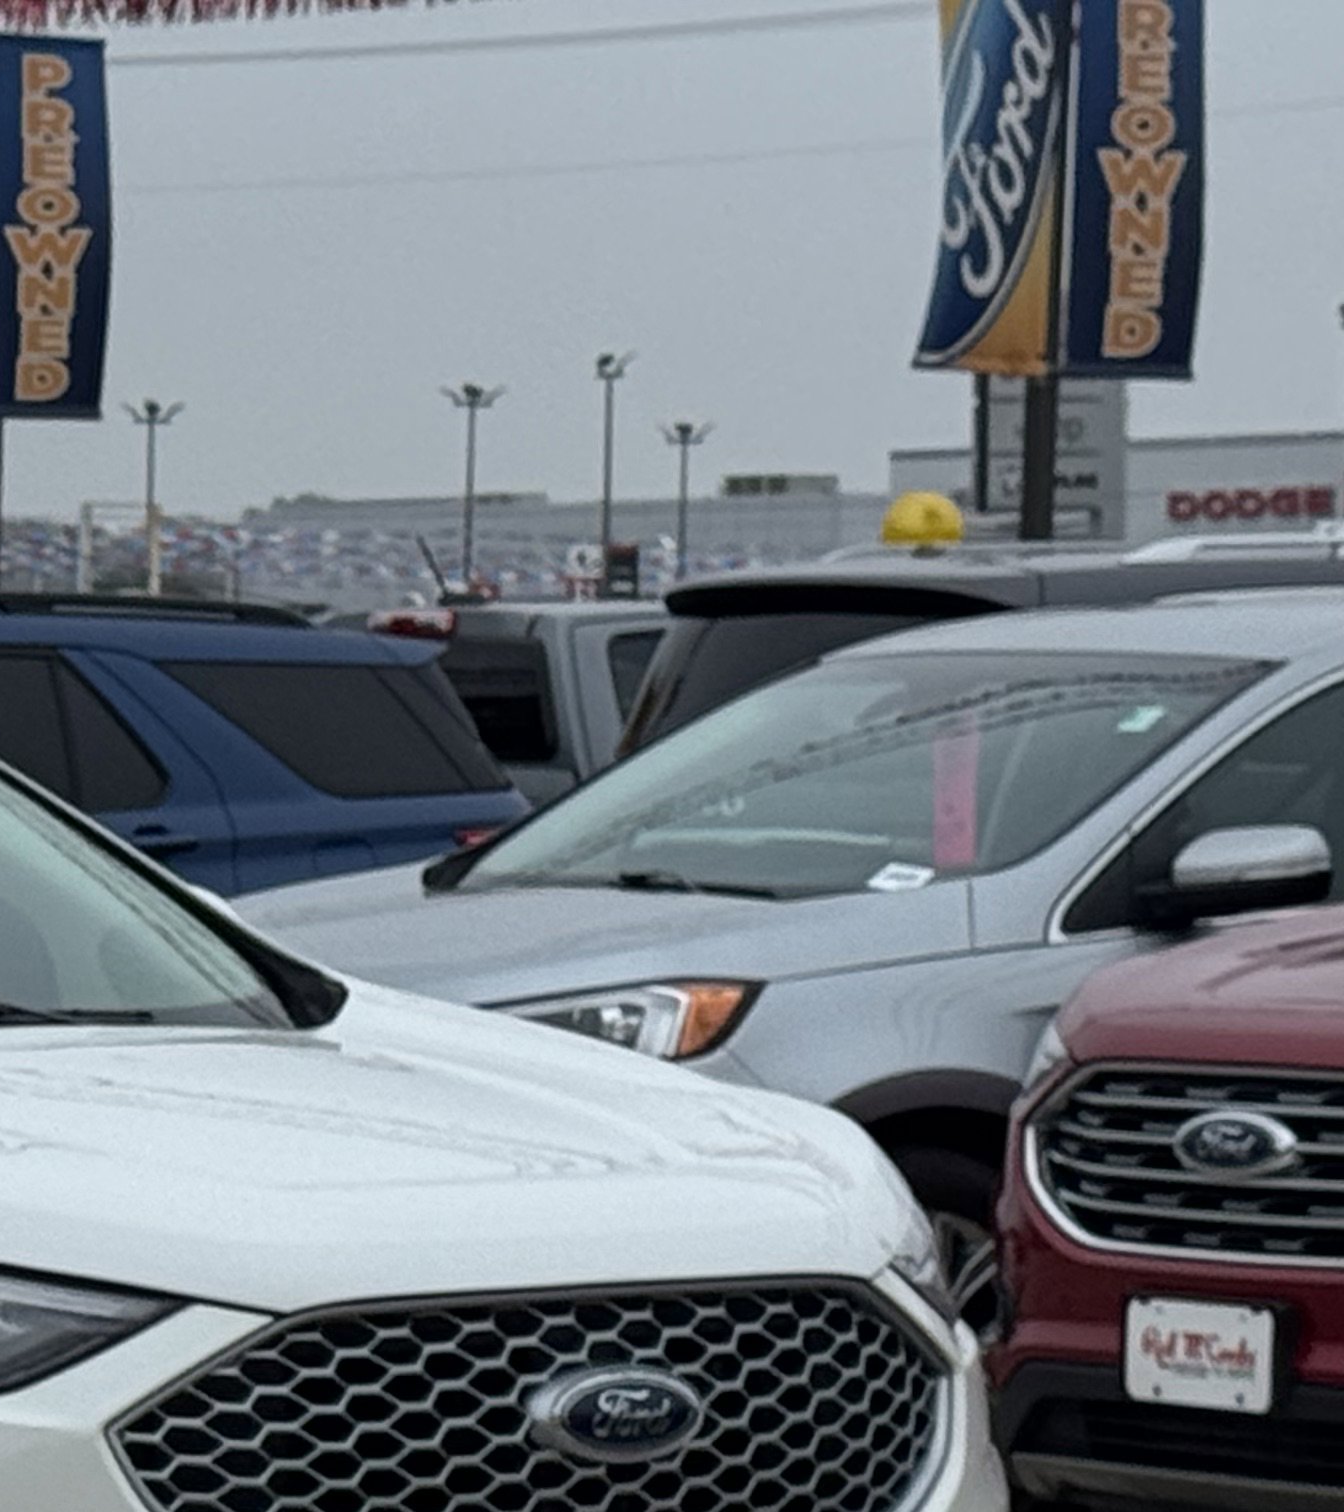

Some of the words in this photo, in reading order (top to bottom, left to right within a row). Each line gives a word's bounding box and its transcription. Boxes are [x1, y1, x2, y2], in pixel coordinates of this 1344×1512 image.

[3, 52, 93, 401] PREOWNED
[940, 0, 1054, 299] Ford
[1097, 0, 1189, 358] REOWNED
[1166, 486, 1335, 522] DODGE
[592, 1388, 673, 1439] Ford
